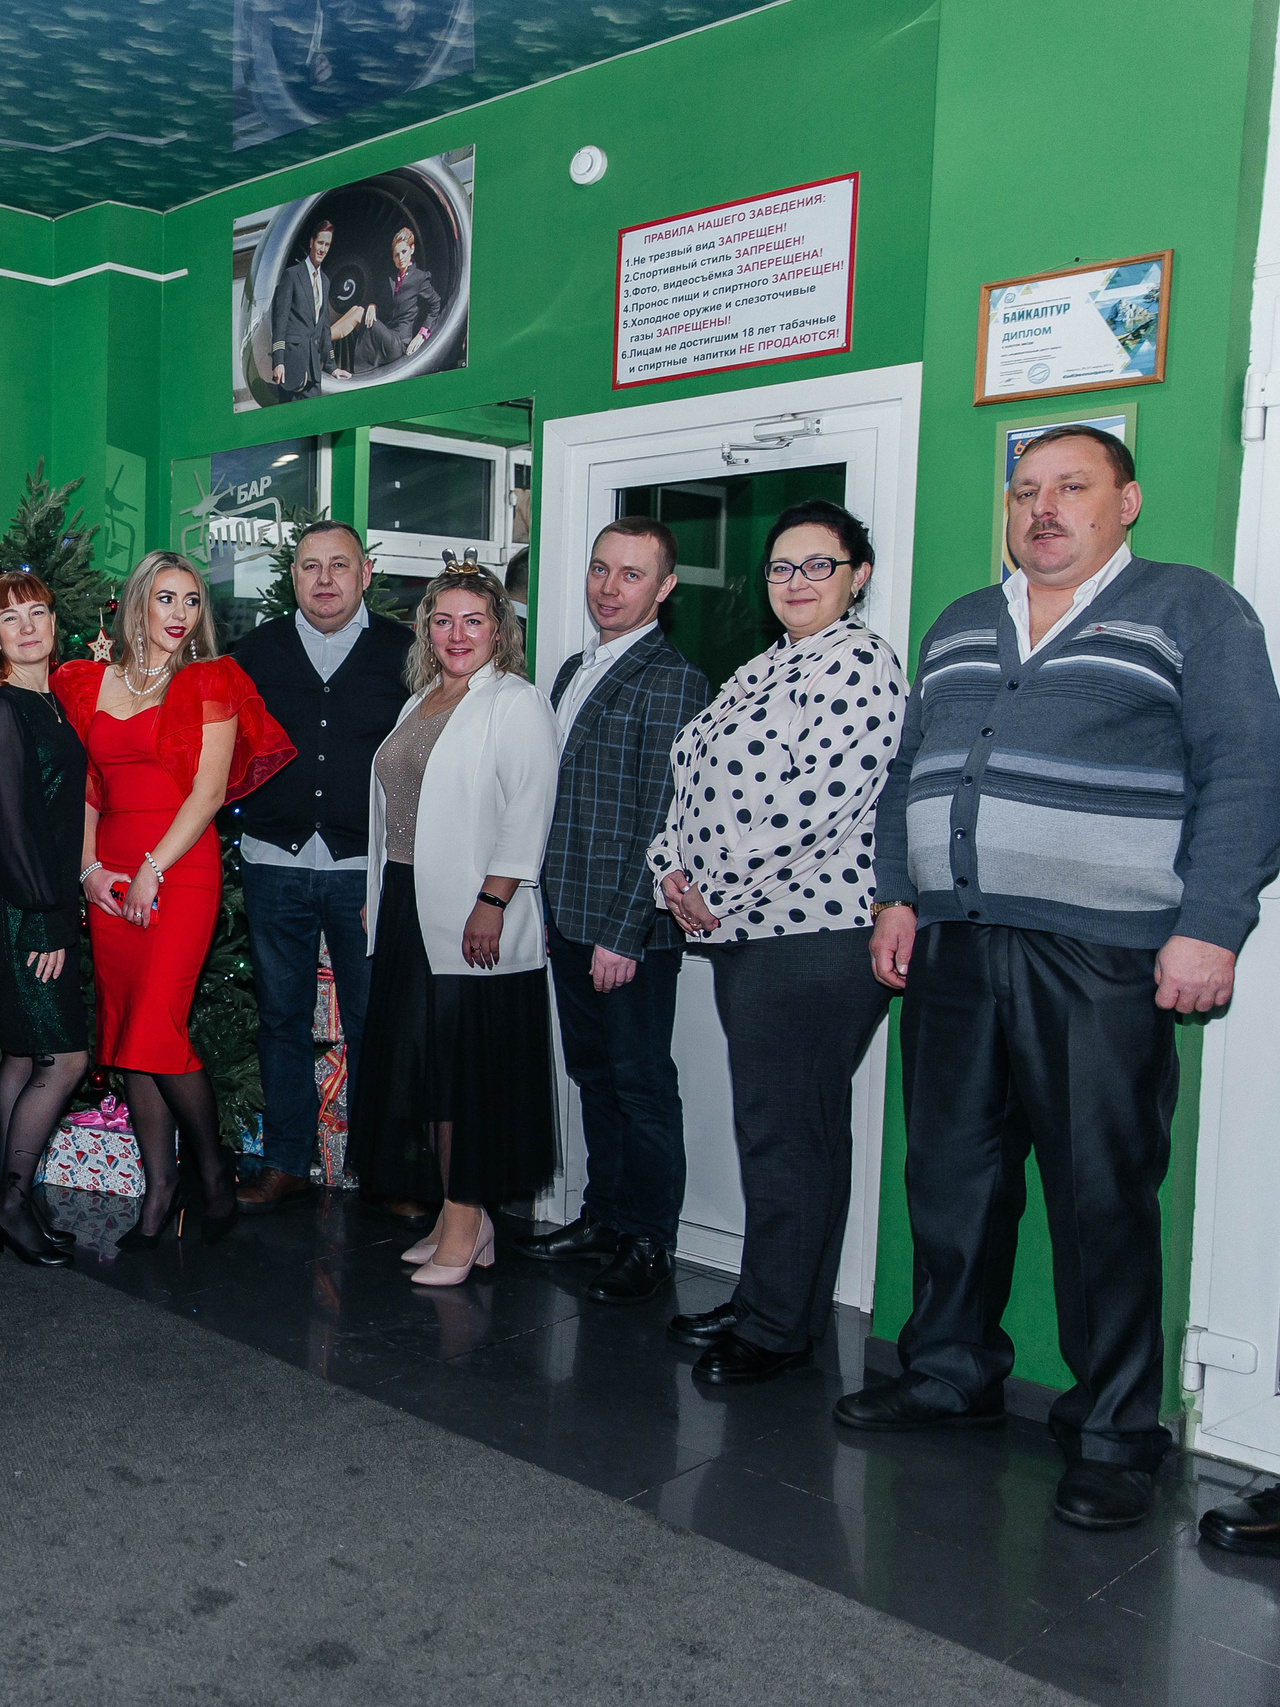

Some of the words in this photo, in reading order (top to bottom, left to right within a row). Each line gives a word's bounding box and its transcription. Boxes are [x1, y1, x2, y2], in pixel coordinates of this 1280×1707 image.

[644, 225, 694, 244] ПРАВИЛА
[697, 212, 746, 232] НАШЕГО
[749, 193, 826, 220] ЗАВЕДЕНИЯ:
[624, 259, 698, 283] 2.Спортивный
[700, 253, 732, 267] стиль
[735, 235, 805, 259] ЗАПРЕЩЕН!
[625, 256, 646, 268] 1.Не
[649, 244, 692, 263] трезвый
[695, 241, 716, 252] вид
[718, 222, 787, 247] ЗАПРЕЩЕН!
[623, 285, 660, 299] 3.Фото,
[663, 269, 734, 290] видеосъёмка
[736, 248, 823, 275] ЗАПЕРЕЩЕНА!
[623, 298, 669, 313] 4.Пронос
[671, 292, 700, 304] пищи
[702, 290, 709, 298] и
[712, 278, 769, 296] спиртного
[772, 260, 844, 284] ЗАПРЕЩЕН!
[622, 311, 680, 329] 5.Холодное
[683, 303, 722, 318] оружие
[725, 301, 732, 309] и
[735, 284, 816, 307] слезоточивые
[630, 332, 654, 343] газы
[656, 315, 731, 338] ЗАПРЕЩЕНЫ!
[1003, 303, 1071, 324] БАЙКАЛТУР
[621, 345, 662, 359] 6.Лицам
[664, 343, 677, 352] не
[679, 331, 739, 350] достигшим
[742, 327, 754, 338] 18
[757, 325, 776, 336] лет
[779, 314, 836, 331] табачные
[629, 366, 635, 374] и
[637, 356, 688, 372] спиртные
[693, 347, 737, 362] напитки
[739, 343, 755, 354] НЕ
[758, 329, 839, 351] ПРОДАЮТСЯ!
[1001, 326, 1052, 343] ДИПЛОМ
[237, 475, 272, 504] БАР
